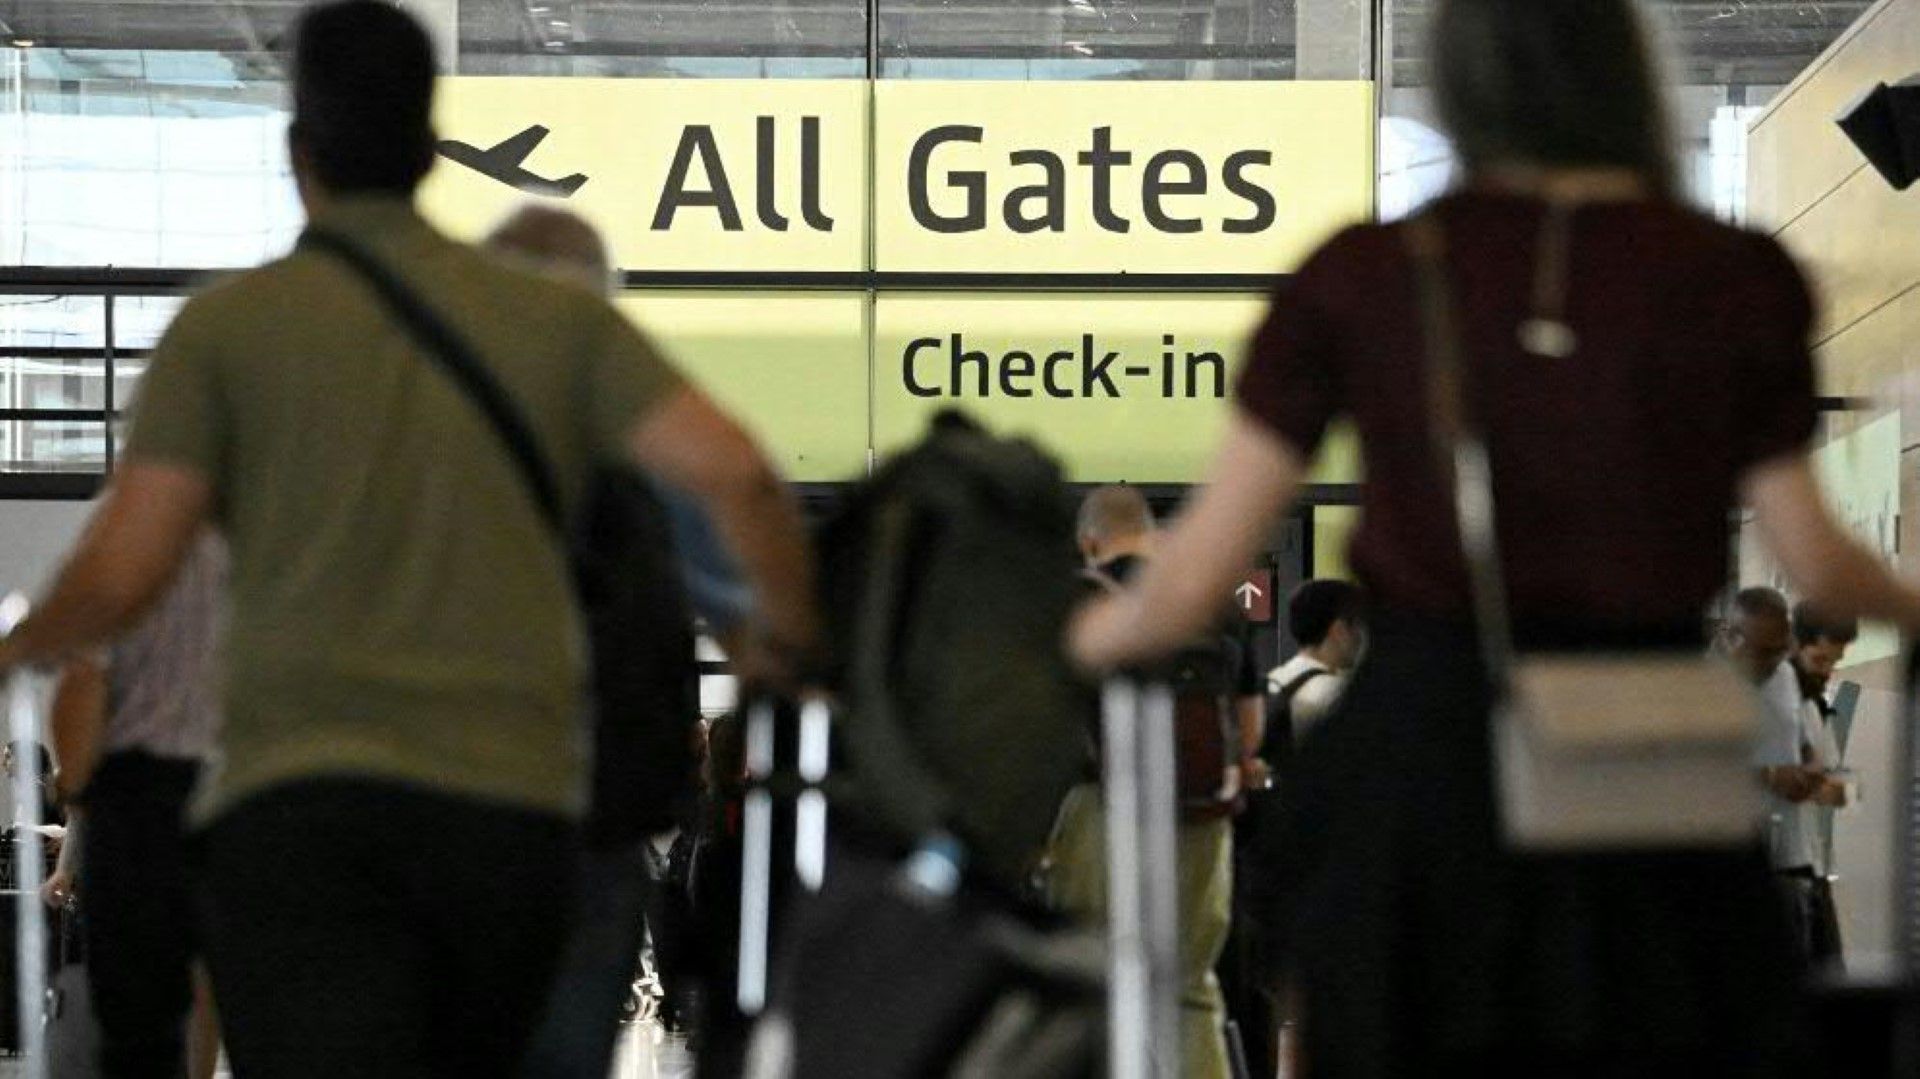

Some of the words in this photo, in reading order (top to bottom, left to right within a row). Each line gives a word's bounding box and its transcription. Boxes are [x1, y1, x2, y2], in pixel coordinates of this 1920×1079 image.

[650, 116, 835, 232] All
[907, 124, 1277, 234] Gates
[902, 333, 1225, 398] Check-in
